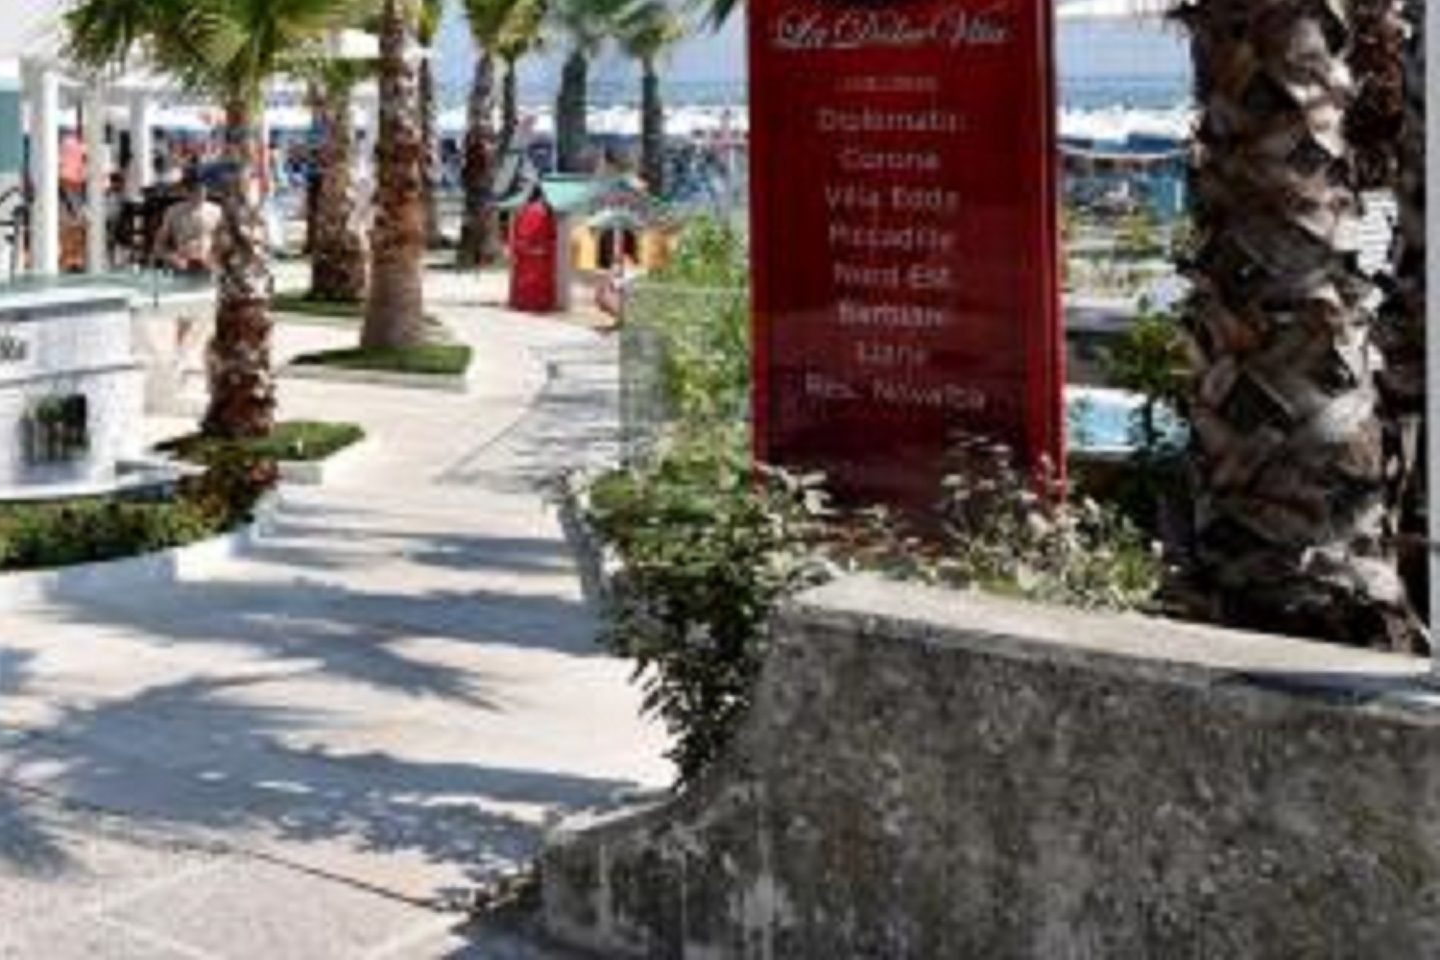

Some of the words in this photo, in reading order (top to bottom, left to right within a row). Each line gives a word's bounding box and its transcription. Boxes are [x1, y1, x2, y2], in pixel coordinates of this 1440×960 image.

[773, 6, 828, 50] La
[831, 5, 926, 50] Dolce
[928, 0, 1012, 51] Vita
[840, 149, 941, 170] Corona
[824, 185, 879, 208] Villa
